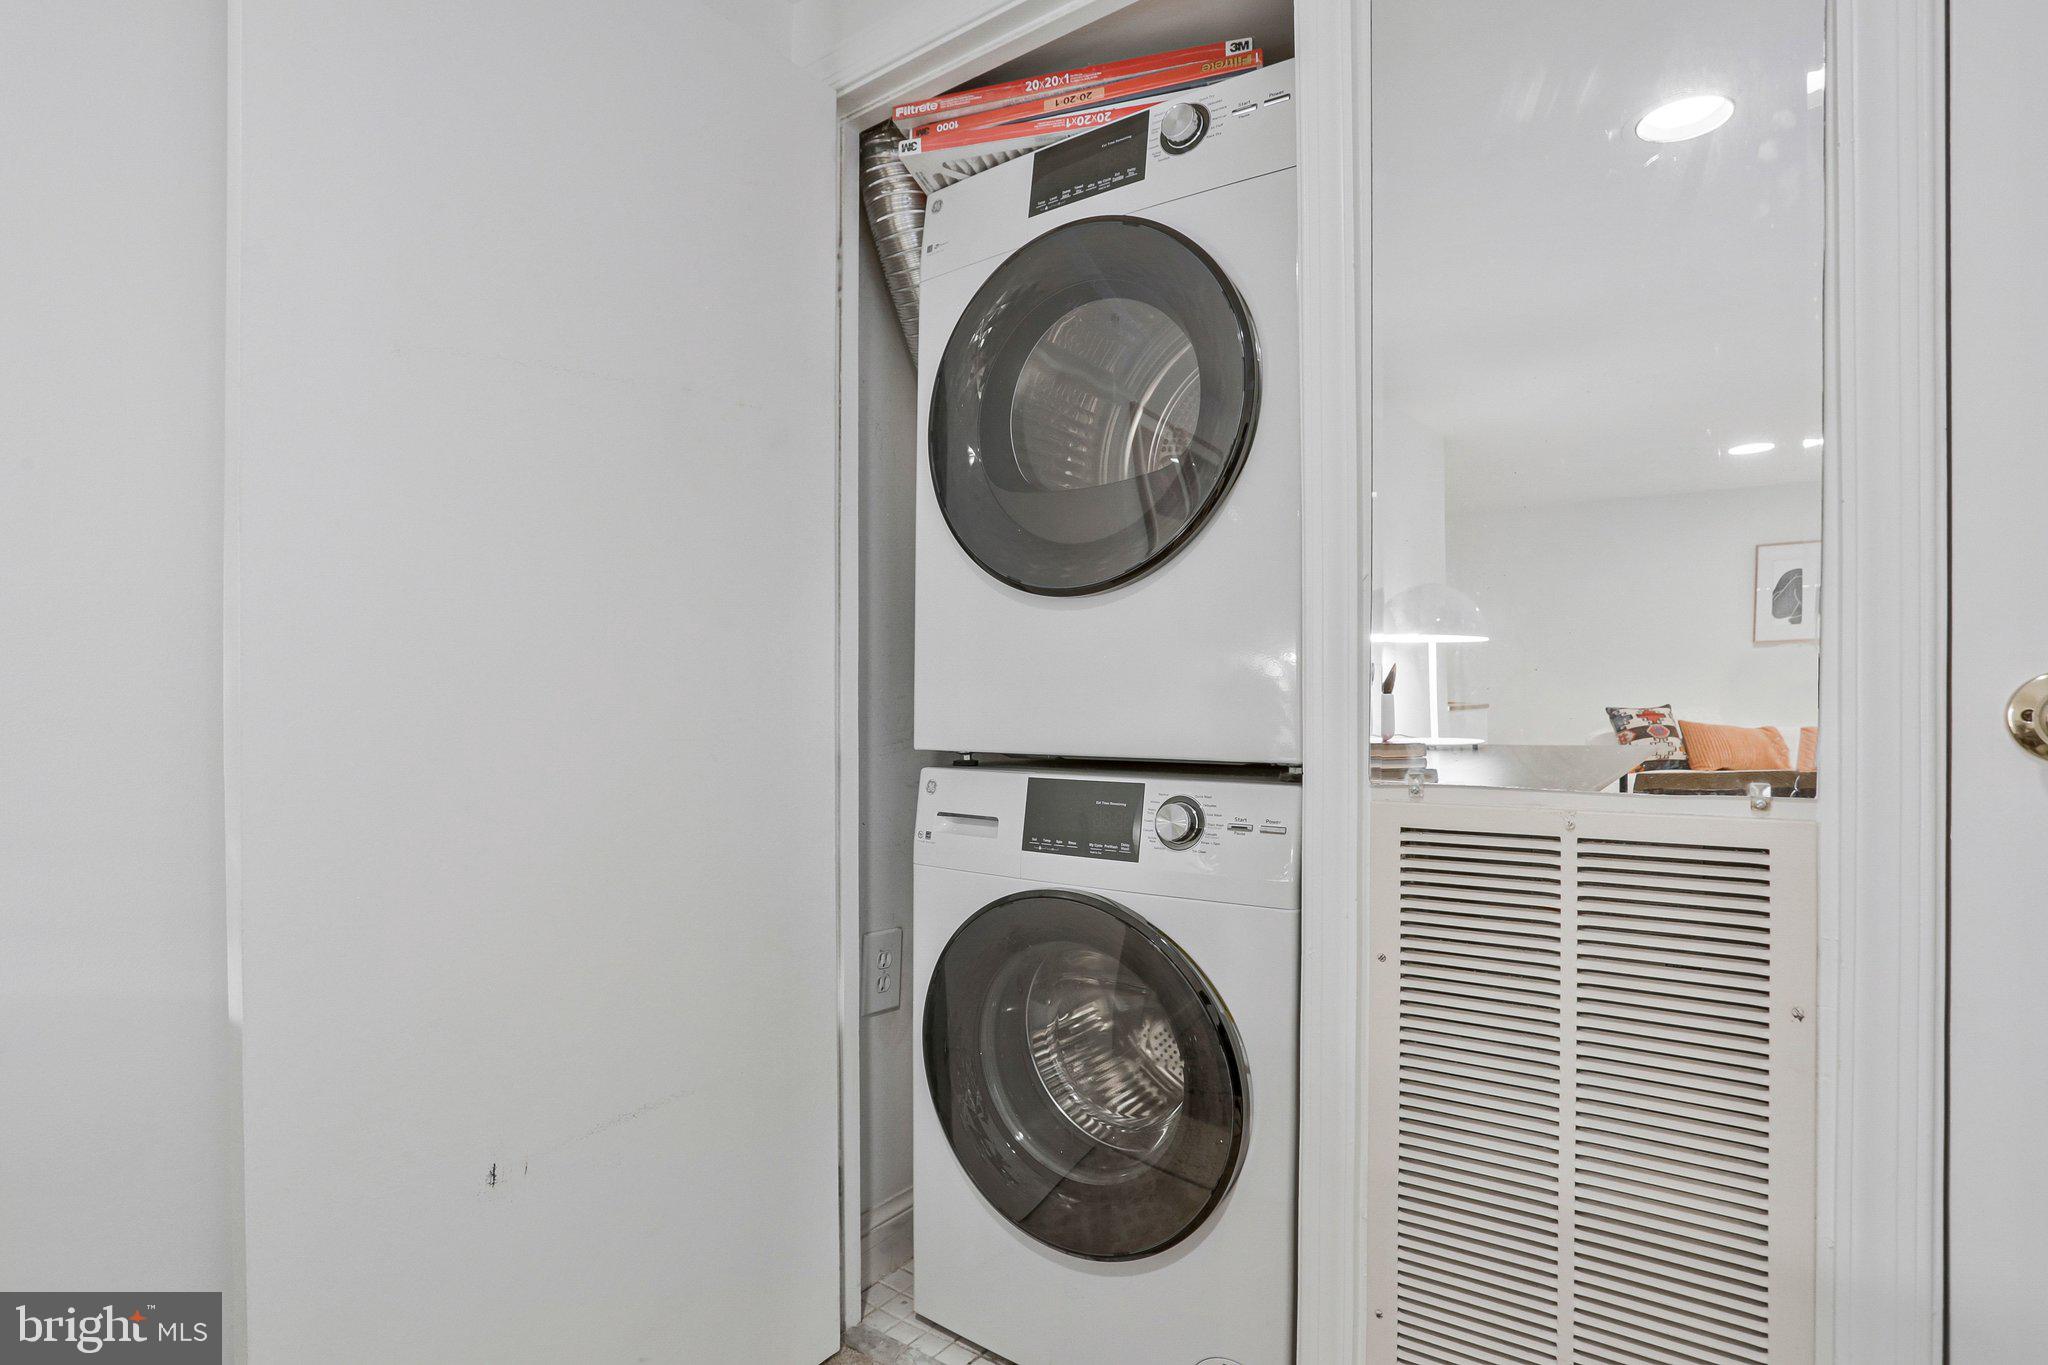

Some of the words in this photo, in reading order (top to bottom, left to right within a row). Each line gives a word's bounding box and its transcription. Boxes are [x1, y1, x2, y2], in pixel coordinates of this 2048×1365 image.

[1229, 40, 1250, 53] 3M
[1025, 73, 1070, 92] 20x20x1
[1268, 90, 1285, 98] Power
[895, 102, 939, 118] Filtrete
[1065, 111, 1112, 128] 20x20x1
[936, 121, 959, 132] 1000
[901, 141, 918, 153] 3M
